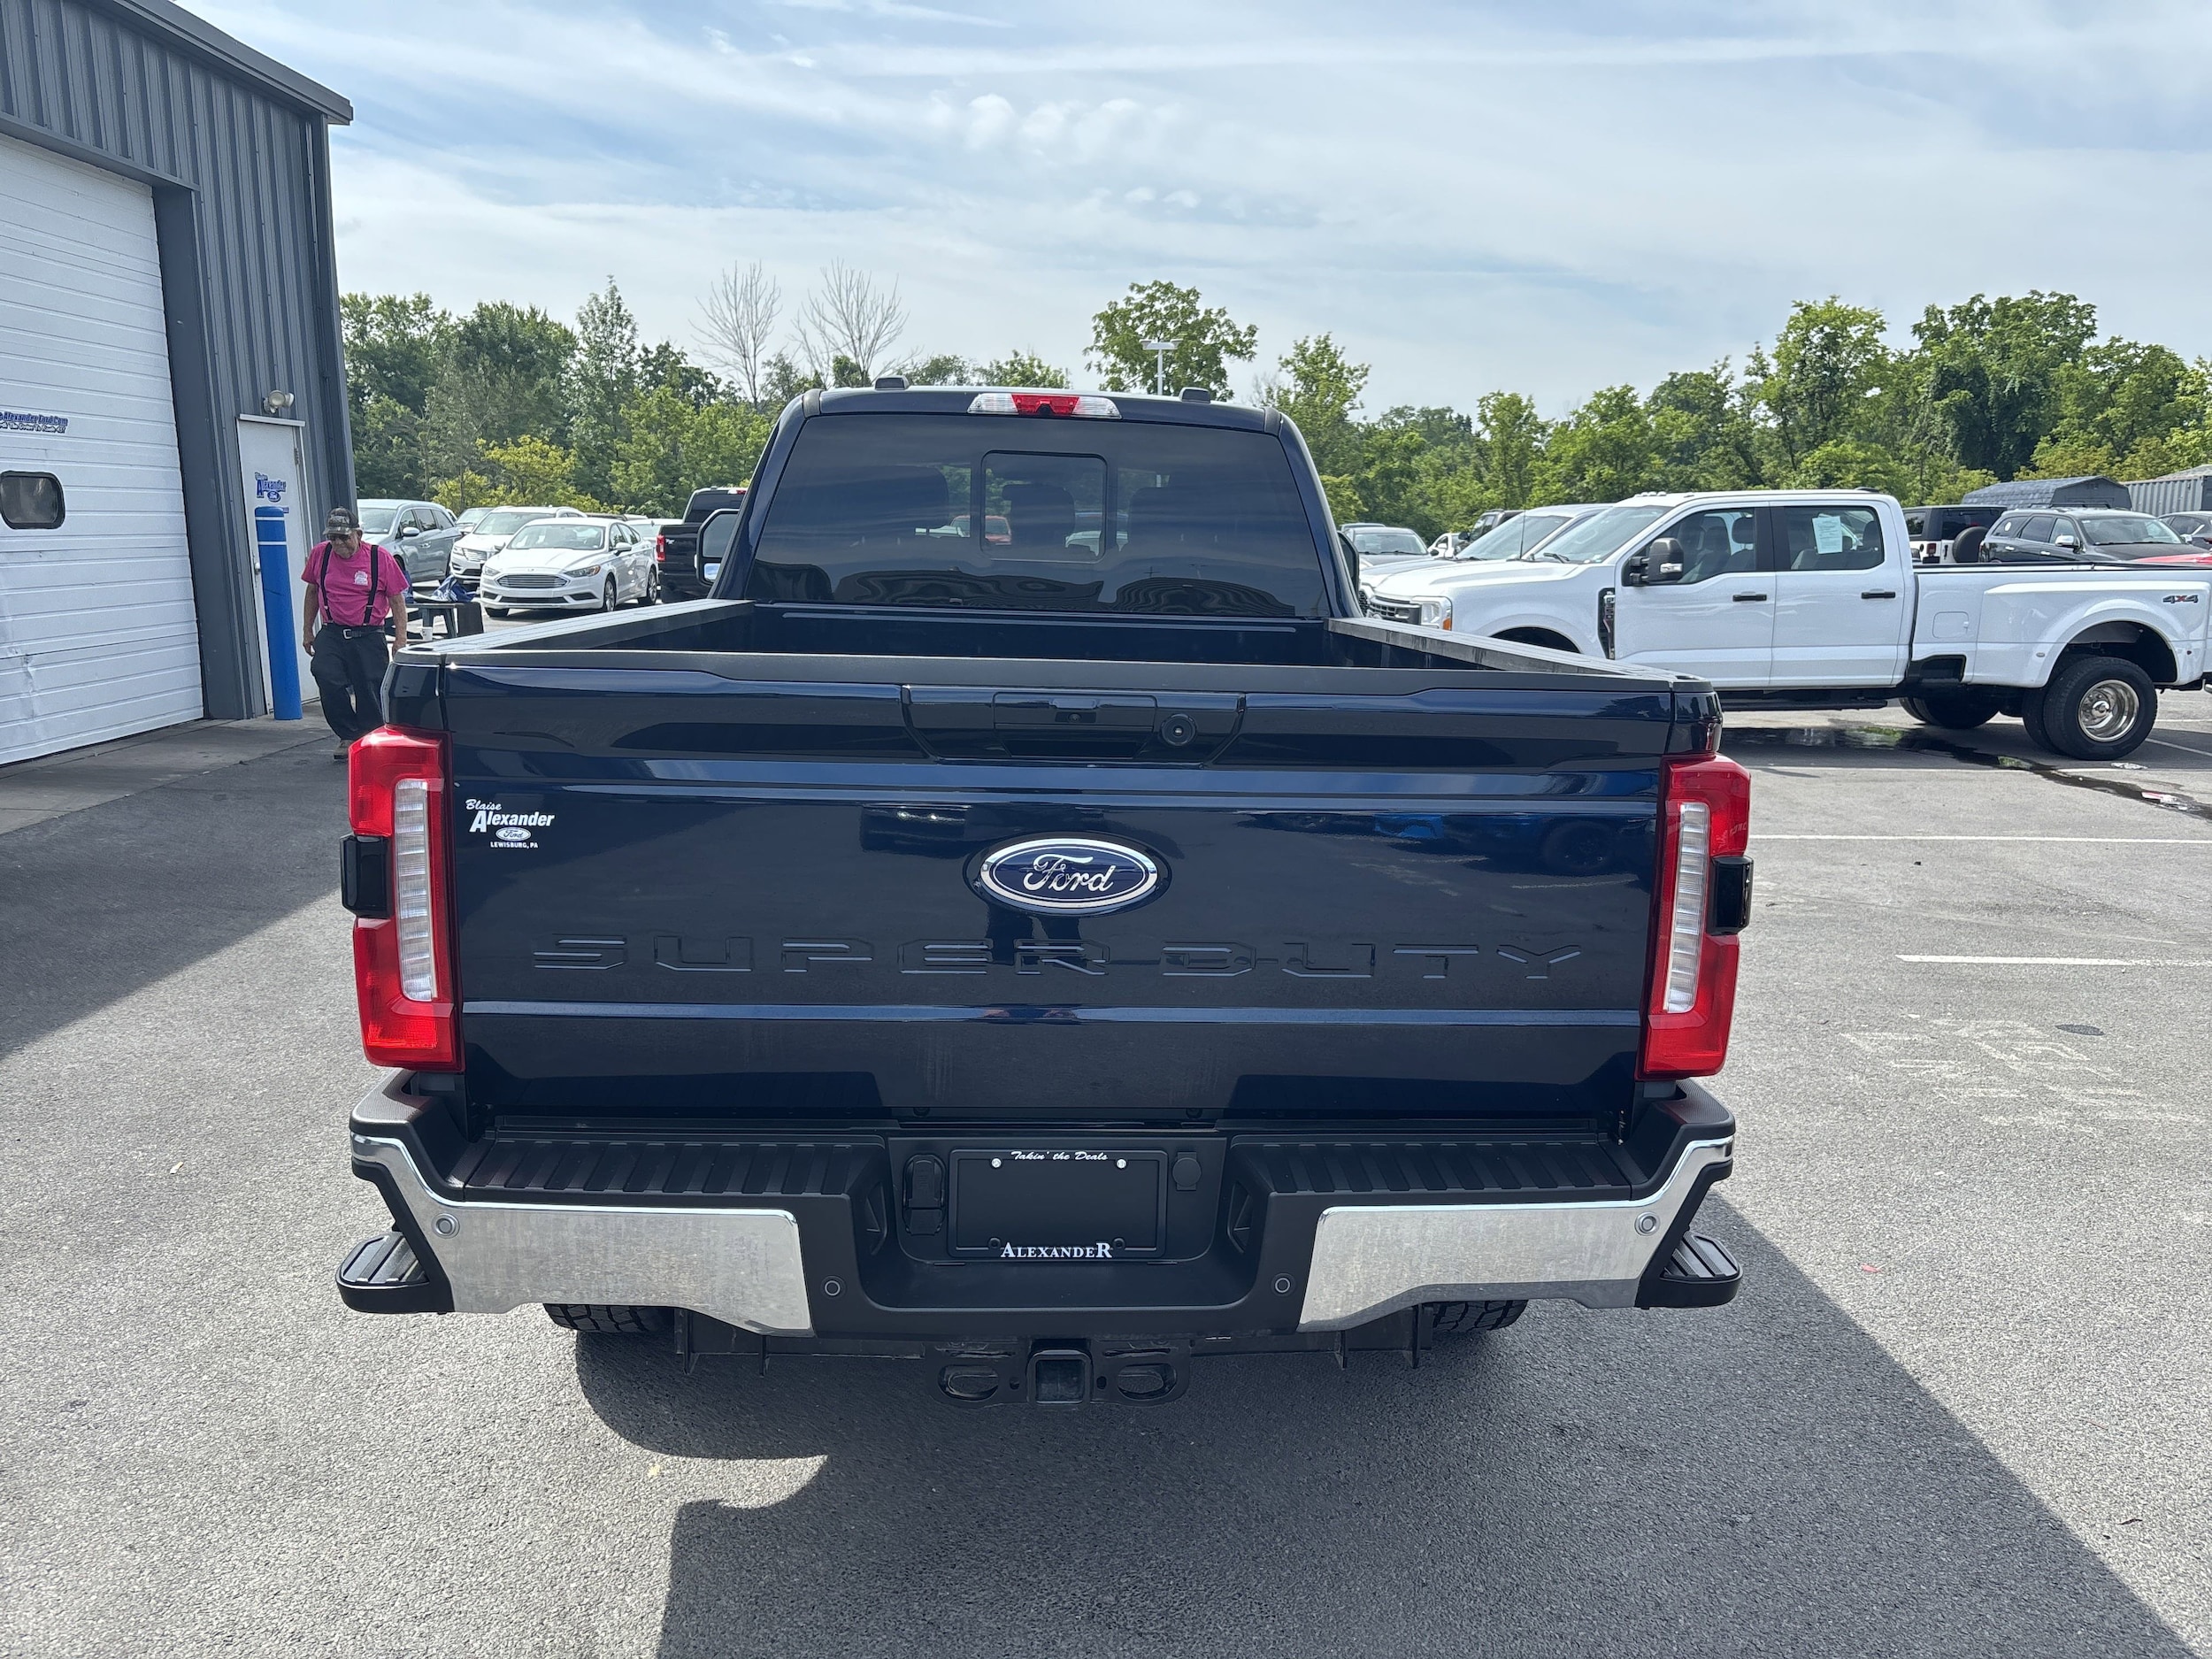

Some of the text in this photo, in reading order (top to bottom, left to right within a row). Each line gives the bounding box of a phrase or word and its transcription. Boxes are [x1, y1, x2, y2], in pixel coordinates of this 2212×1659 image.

[465, 798, 502, 810] Blaise
[469, 810, 556, 833] Alexander
[503, 829, 524, 839] Ford
[1023, 853, 1117, 892] Ford
[533, 933, 1582, 979] SUPER DUTY
[1010, 1150, 1109, 1161] Takin' the Deals
